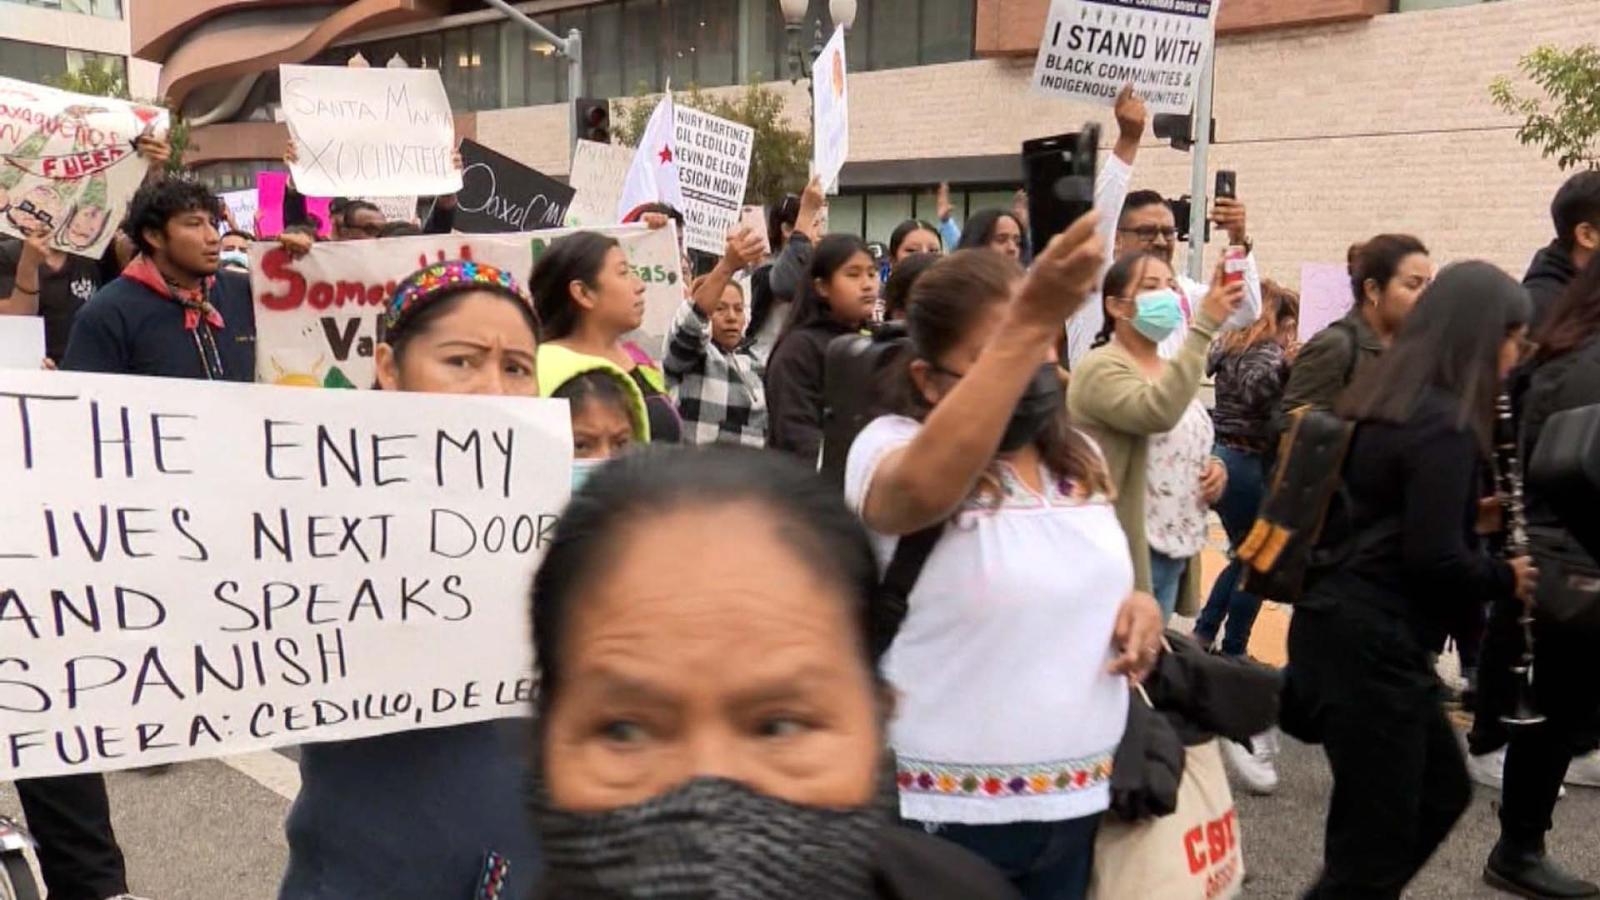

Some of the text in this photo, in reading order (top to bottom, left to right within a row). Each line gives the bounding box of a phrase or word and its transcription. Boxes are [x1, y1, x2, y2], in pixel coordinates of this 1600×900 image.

[1052, 21, 1203, 66] I STAND WITH
[1040, 74, 1116, 98] INDIGENOUS
[1045, 53, 1192, 88] BLACK COMMUNITIES &
[677, 110, 750, 145] NURY MARTINEZ
[41, 148, 125, 177] FUERA
[695, 132, 737, 157] CEDILLO
[738, 146, 747, 161] &
[705, 154, 720, 172] DE
[677, 166, 712, 190] ESIGN
[0, 391, 514, 498] THE ENEMY
[253, 508, 395, 562] NEXT
[0, 575, 472, 639] AND SPEAKS
[0, 628, 346, 713] SPANISH
[9, 714, 234, 768] FUERA:
[249, 691, 422, 739] CEDILLO,
[432, 681, 481, 713] DE
